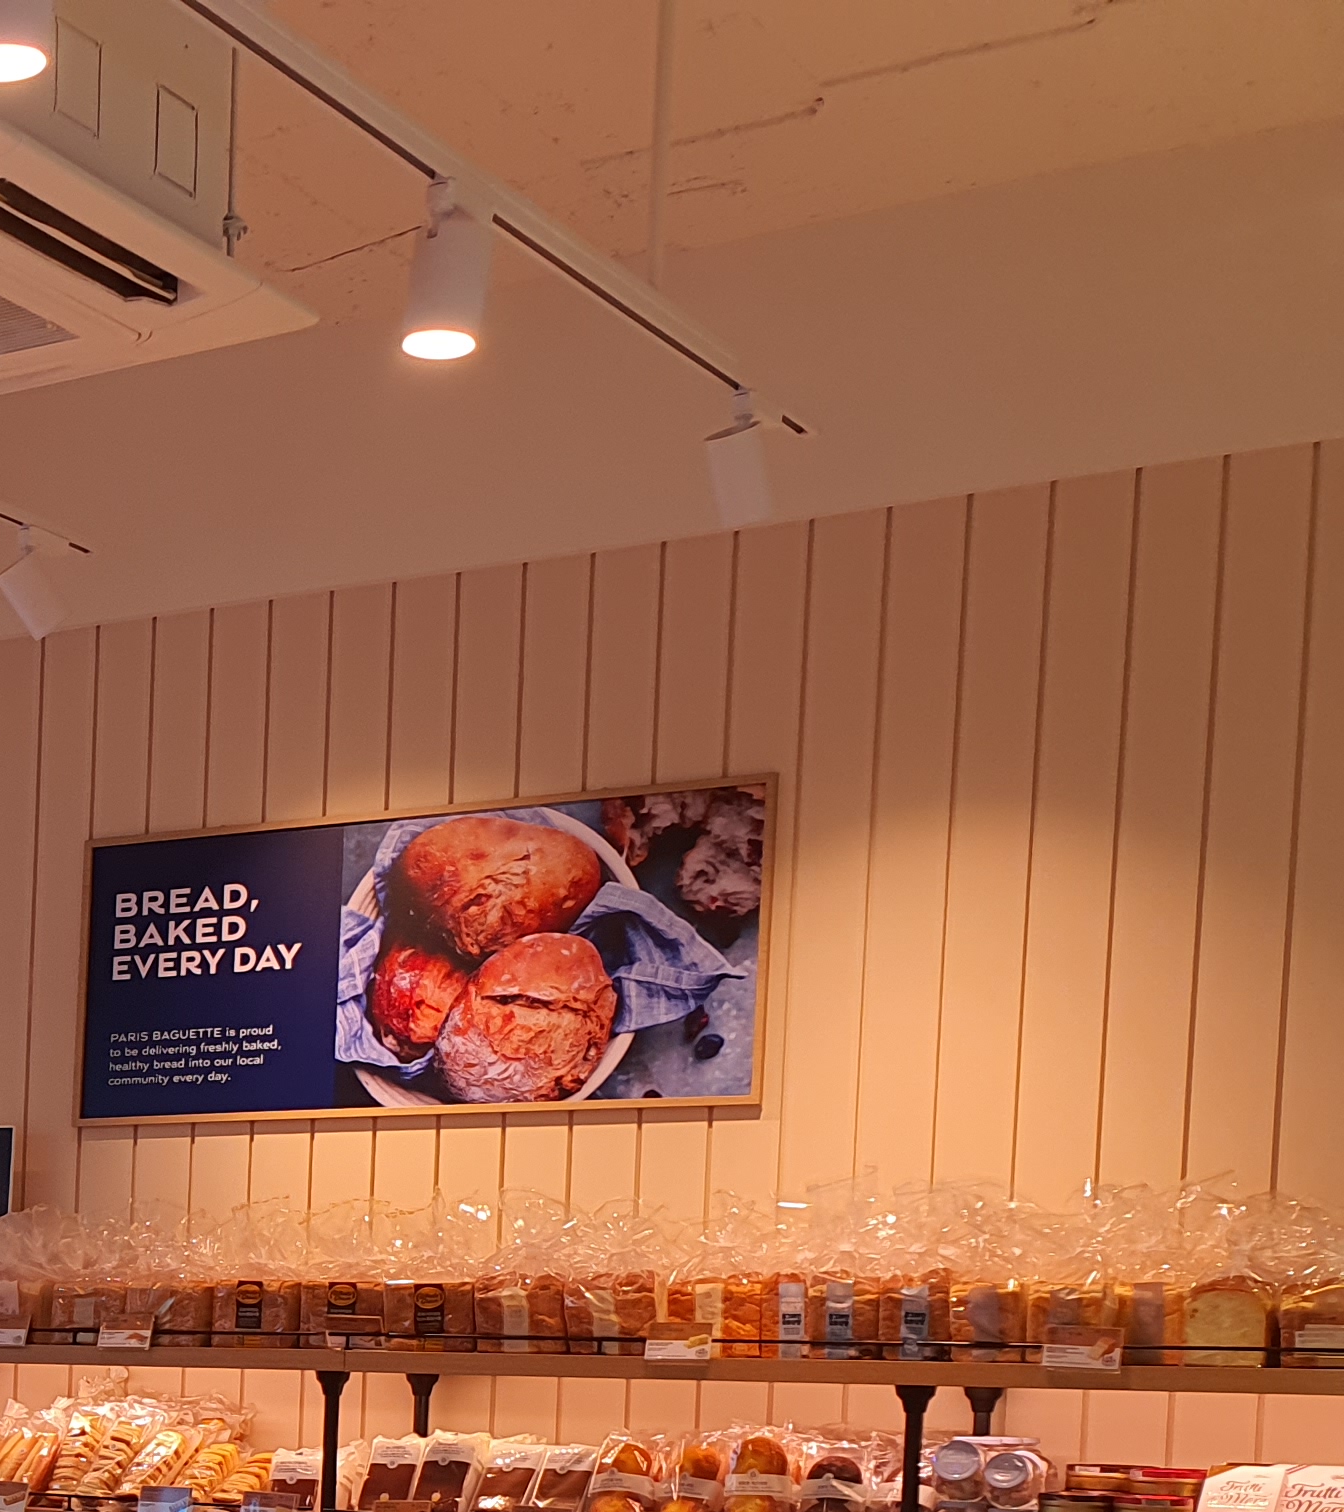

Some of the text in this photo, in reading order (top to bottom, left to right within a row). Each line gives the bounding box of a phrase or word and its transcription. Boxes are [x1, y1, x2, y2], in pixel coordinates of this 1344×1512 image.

[115, 883, 260, 918] BREAD,
[114, 915, 247, 949] BAKED
[112, 942, 302, 981] EVERY DAY
[111, 1024, 273, 1043] PARIS BAGUETTE is proud
[109, 1039, 282, 1057] to be delivering freshly baked,
[109, 1054, 264, 1073] healthy bread into our local
[108, 1071, 232, 1086] community every day.
